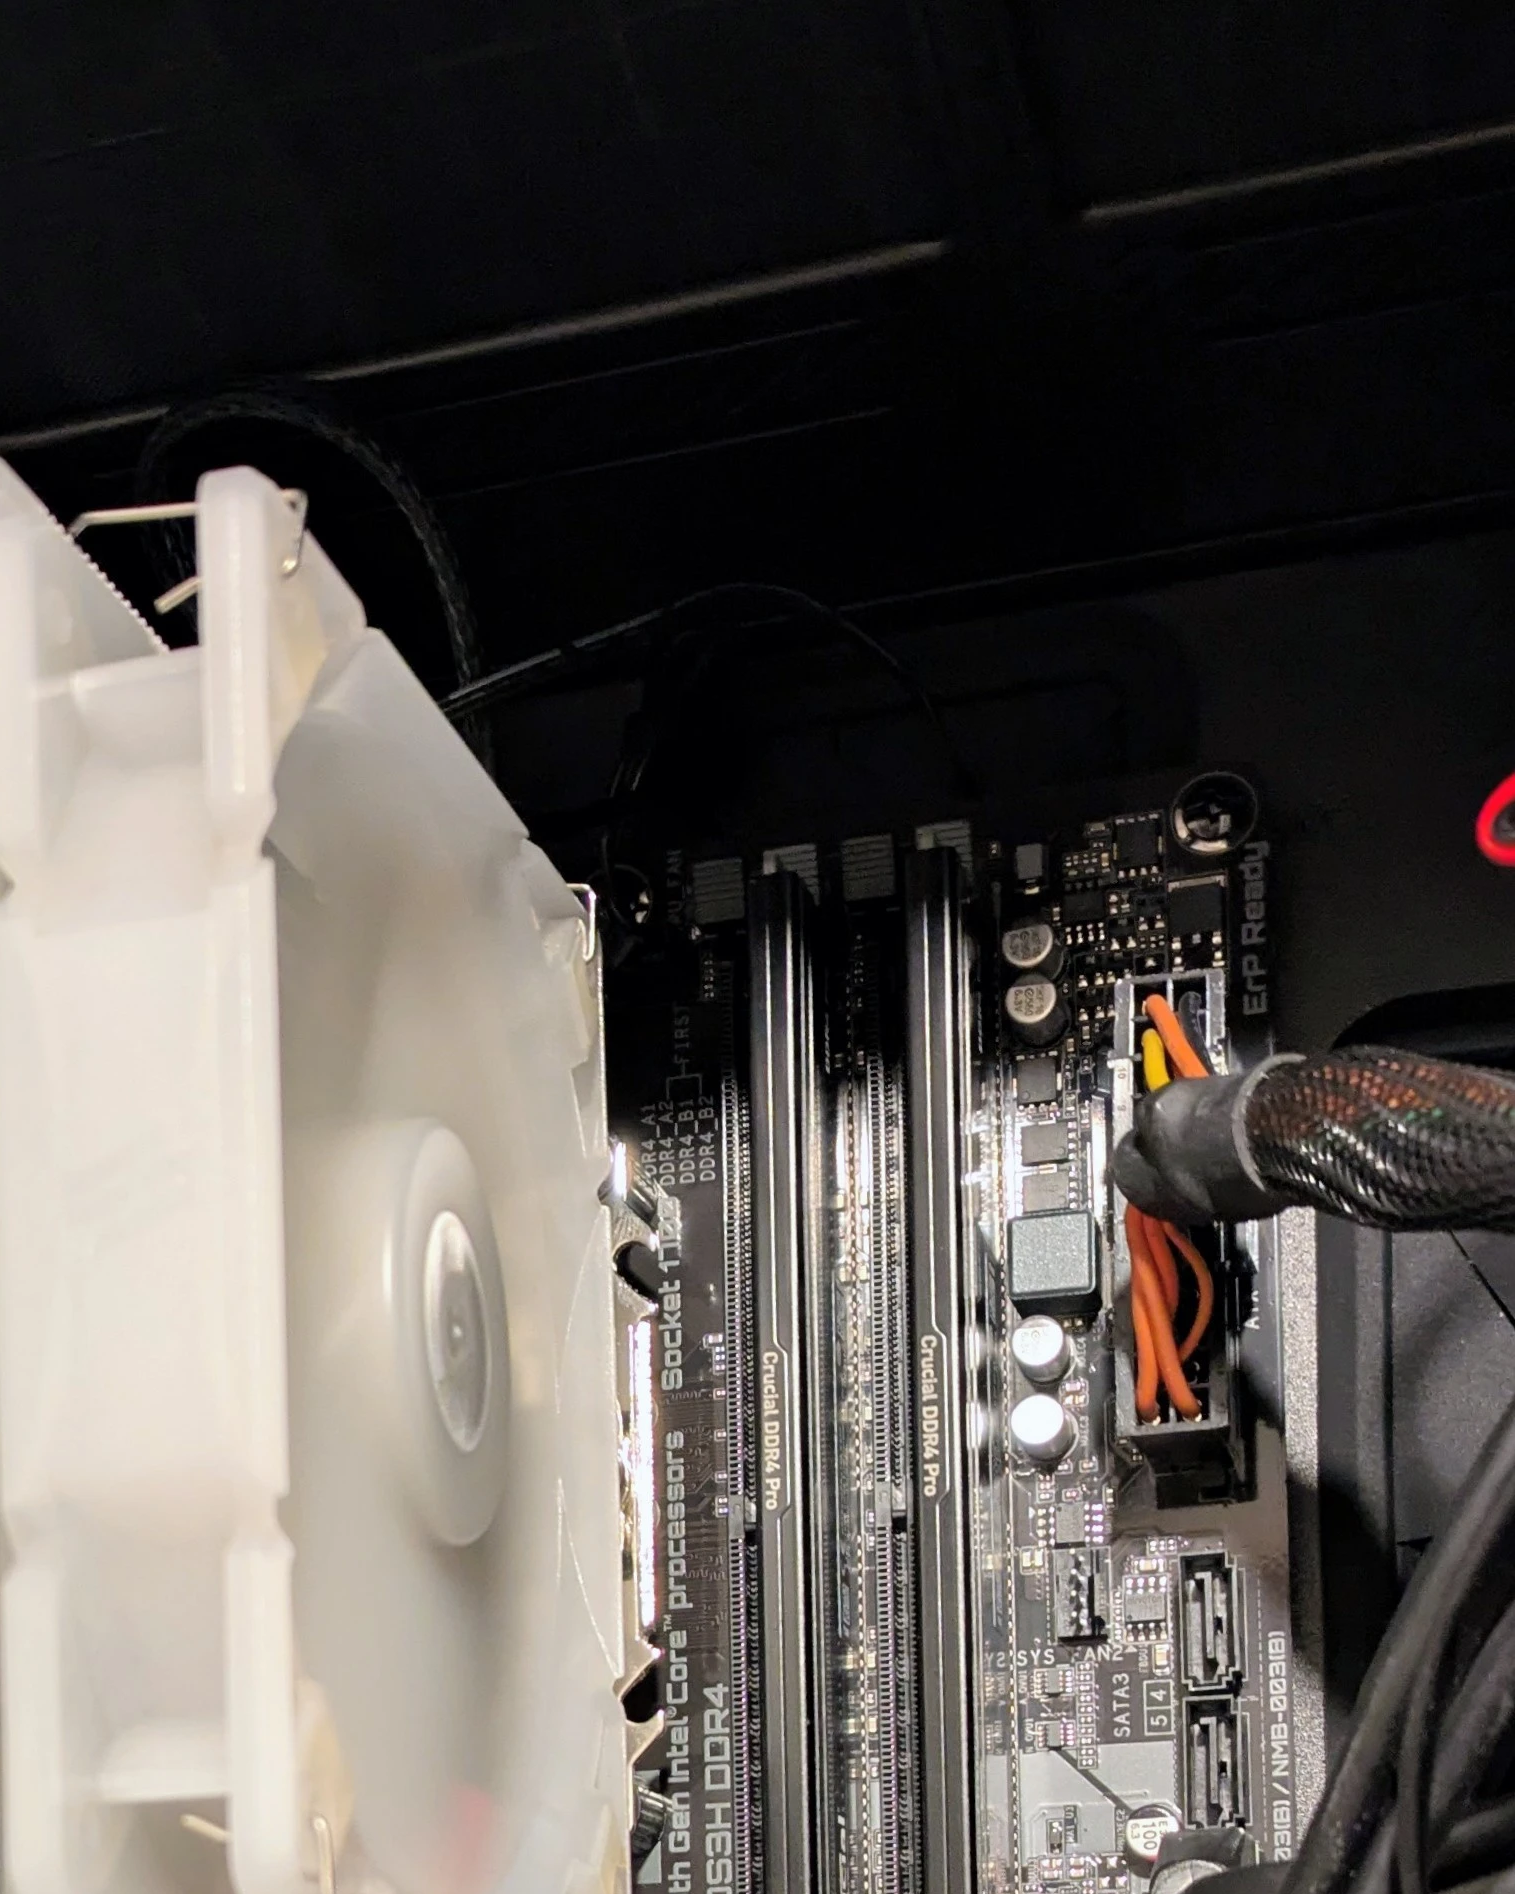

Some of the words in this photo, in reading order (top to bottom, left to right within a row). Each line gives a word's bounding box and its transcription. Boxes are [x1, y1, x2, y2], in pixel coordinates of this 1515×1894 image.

[1238, 840, 1269, 946] Ready
[1241, 954, 1268, 1016] ErP
[673, 1003, 691, 1063] FIRST
[640, 1103, 662, 1178] DR4_A1
[659, 1100, 678, 1187] DDR4_A2
[679, 1098, 699, 1185] DDR4_B1
[699, 1094, 719, 1183] DDR4_B2
[658, 1279, 684, 1391] Socket
[920, 1334, 939, 1401] Crucial
[763, 1350, 779, 1415] Crucial
[764, 1420, 780, 1473] DDR4
[921, 1405, 940, 1460] DDR4
[765, 1476, 781, 1511] Pro
[923, 1463, 940, 1498] Pro
[664, 1429, 692, 1610] processors
[1112, 1672, 1131, 1738] SATA3
[1149, 1689, 1167, 1702] 4
[1150, 1715, 1168, 1727] 5
[702, 1683, 733, 1791] DDR4
[667, 1789, 692, 1847] Gen
[1142, 1822, 1158, 1850] 100
